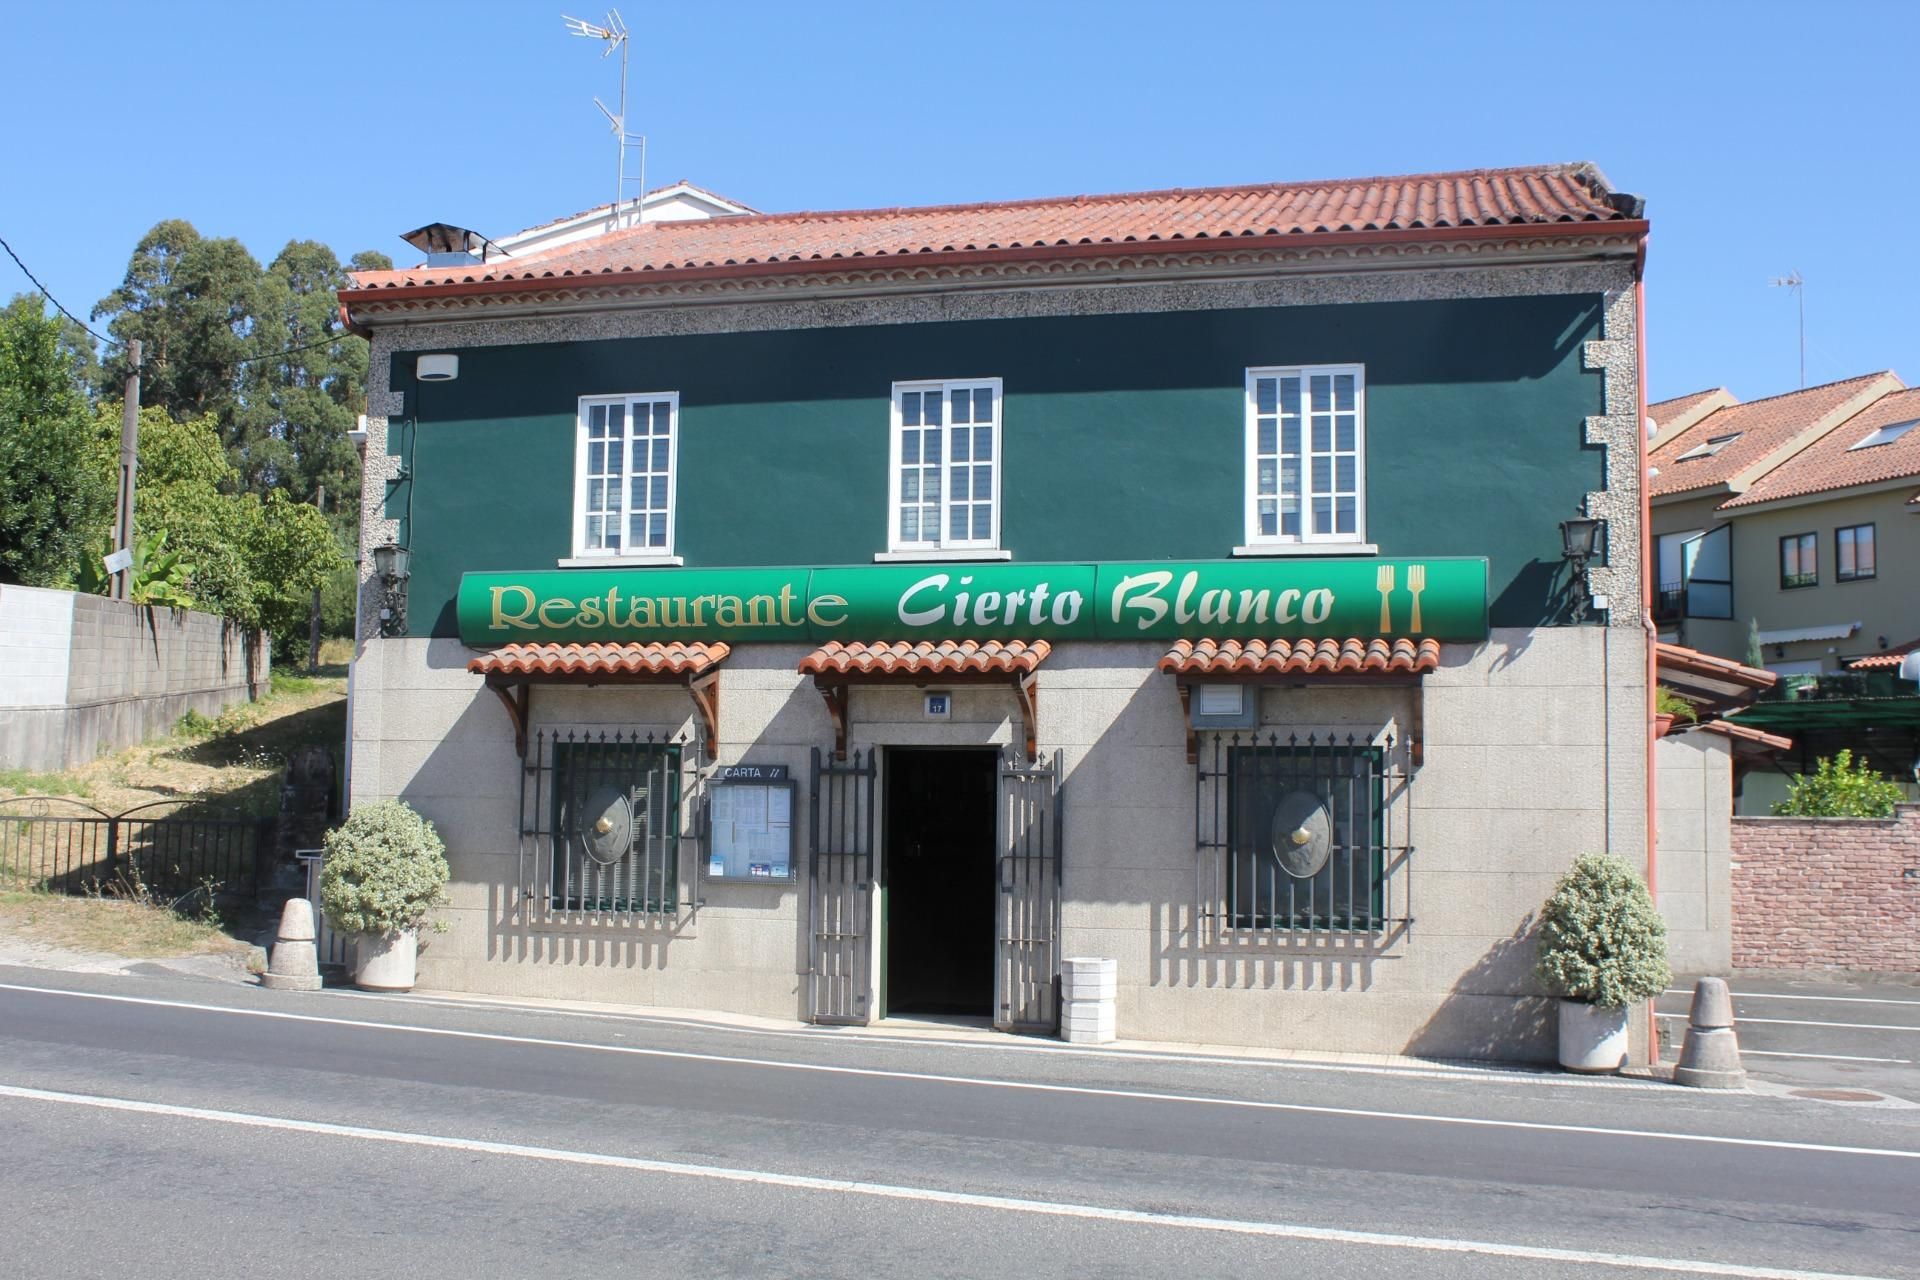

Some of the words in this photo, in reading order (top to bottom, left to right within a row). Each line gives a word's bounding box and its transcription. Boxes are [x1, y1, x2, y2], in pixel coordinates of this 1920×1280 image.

[489, 583, 849, 630] Restaurante
[897, 574, 1083, 627] Cierto
[1112, 571, 1335, 630] Blanco
[725, 767, 761, 778] CARTA
